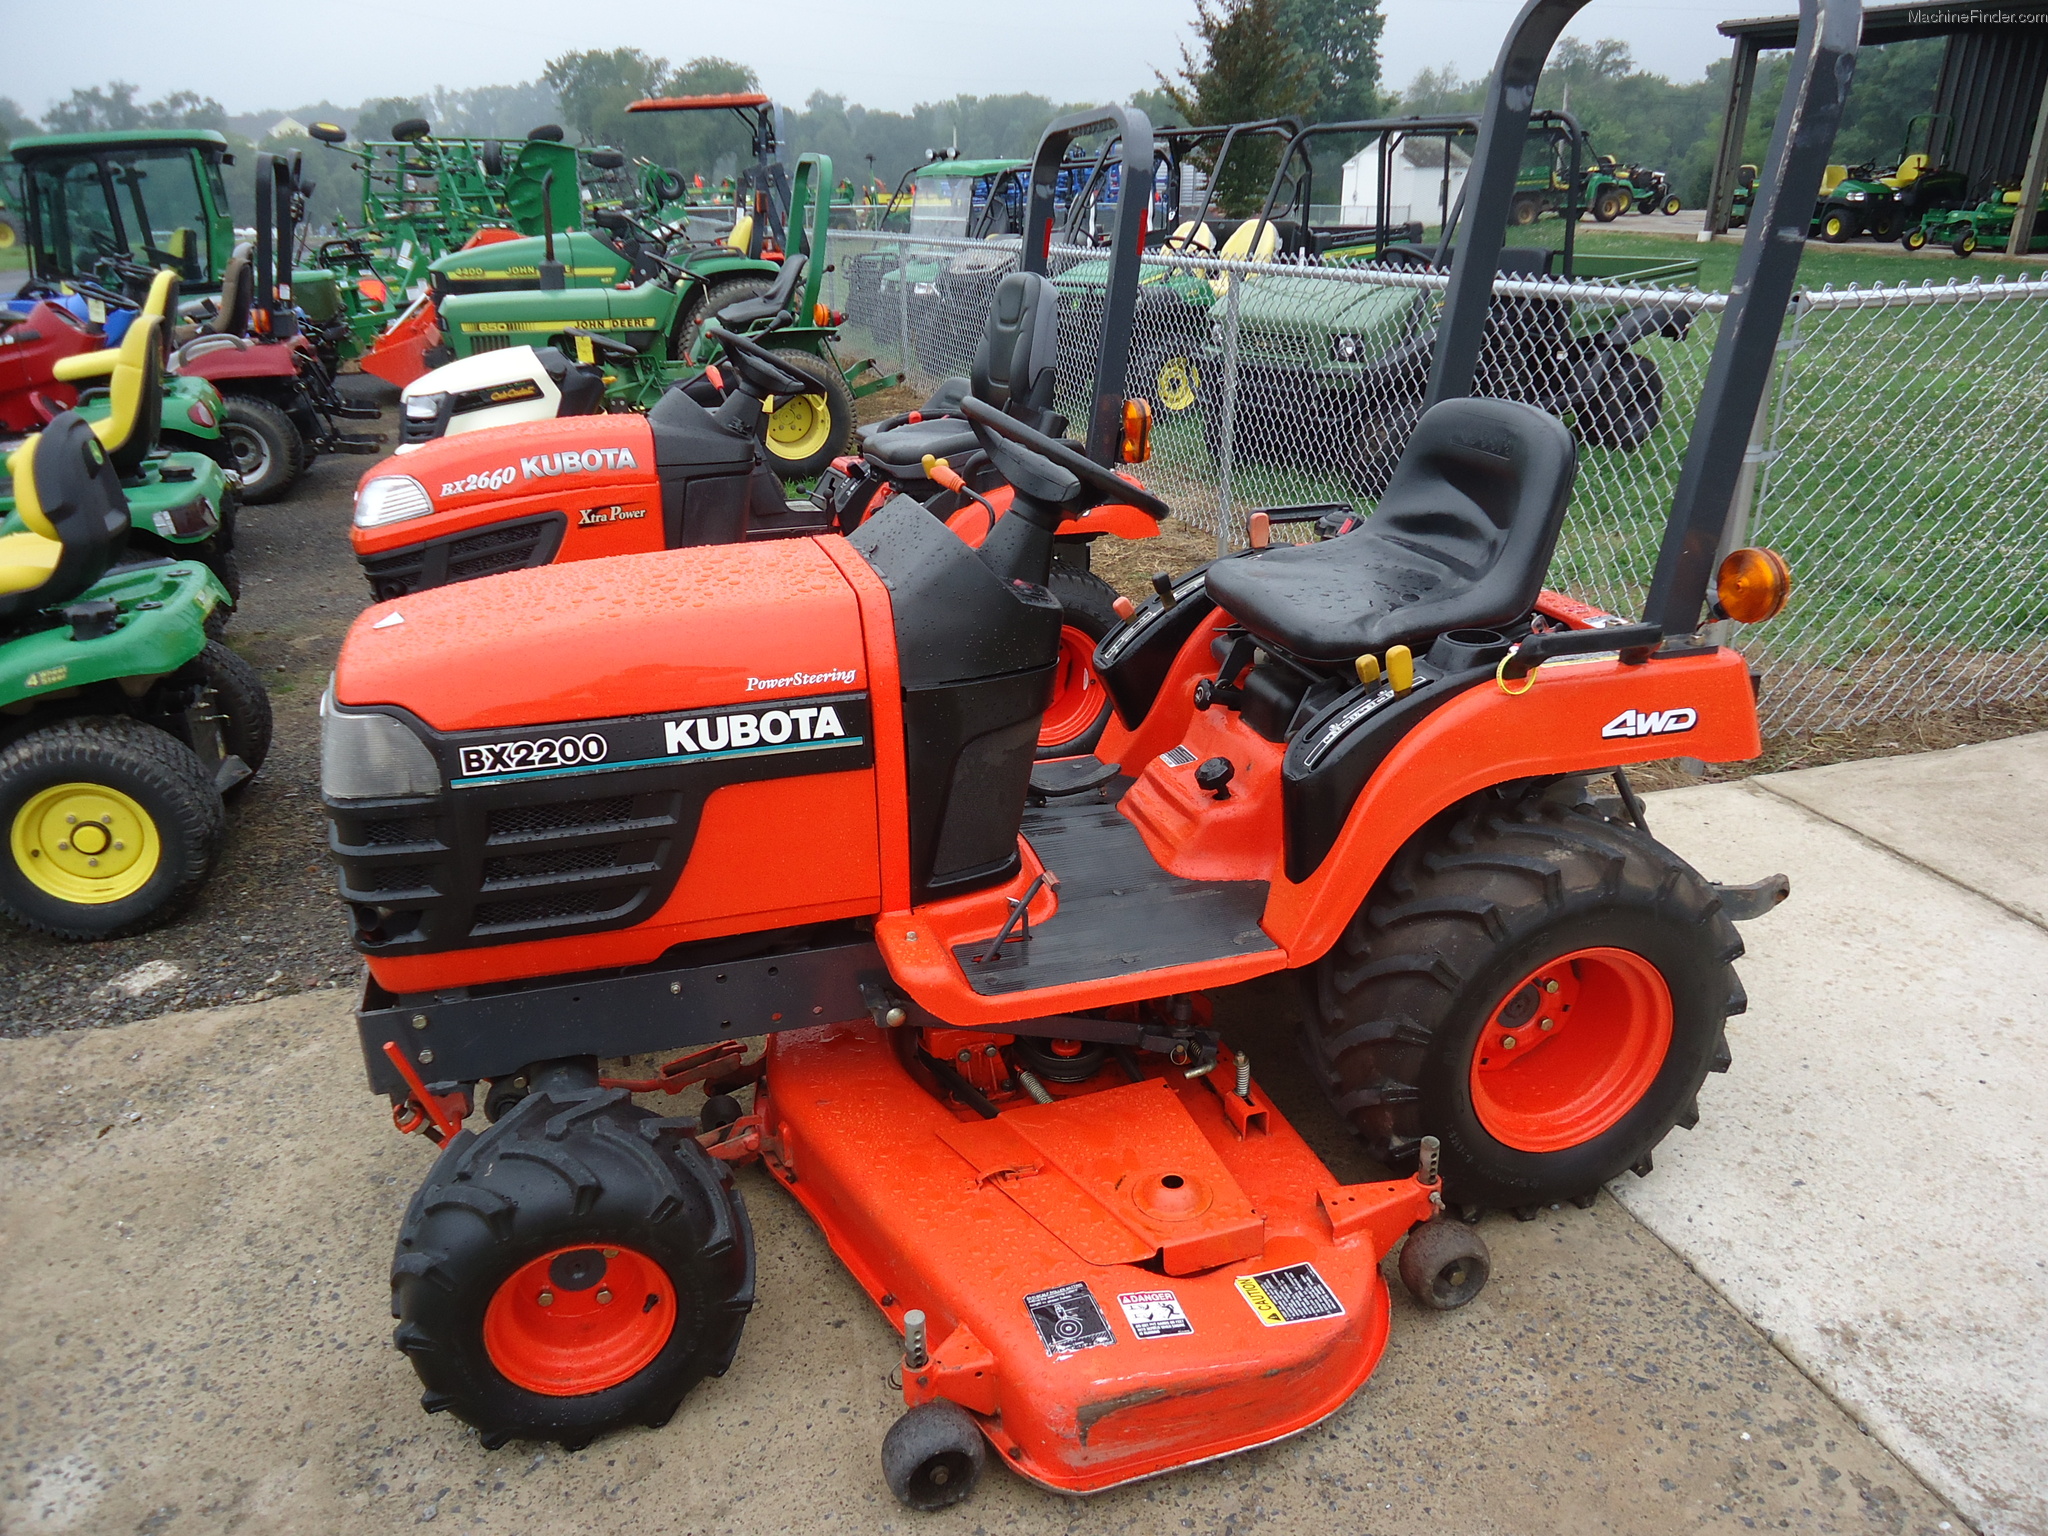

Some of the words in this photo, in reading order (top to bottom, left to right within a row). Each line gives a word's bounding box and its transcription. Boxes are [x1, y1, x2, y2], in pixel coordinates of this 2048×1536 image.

[455, 267, 485, 277] 4400
[505, 265, 535, 276] JOHN
[478, 322, 508, 332] 650
[575, 320, 604, 329] JOHN
[611, 319, 648, 328] DEERE
[520, 447, 638, 480] KUBOTA
[440, 466, 516, 498] BX2660
[578, 509, 607, 525] Xtra
[609, 506, 646, 522] Power
[26, 673, 39, 687] 4
[664, 706, 846, 754] KUBOTA
[1602, 708, 1697, 738] 4WD
[459, 733, 608, 776] BX2200
[1130, 1292, 1173, 1303] DANGER
[1238, 1278, 1272, 1311] CAUTION
